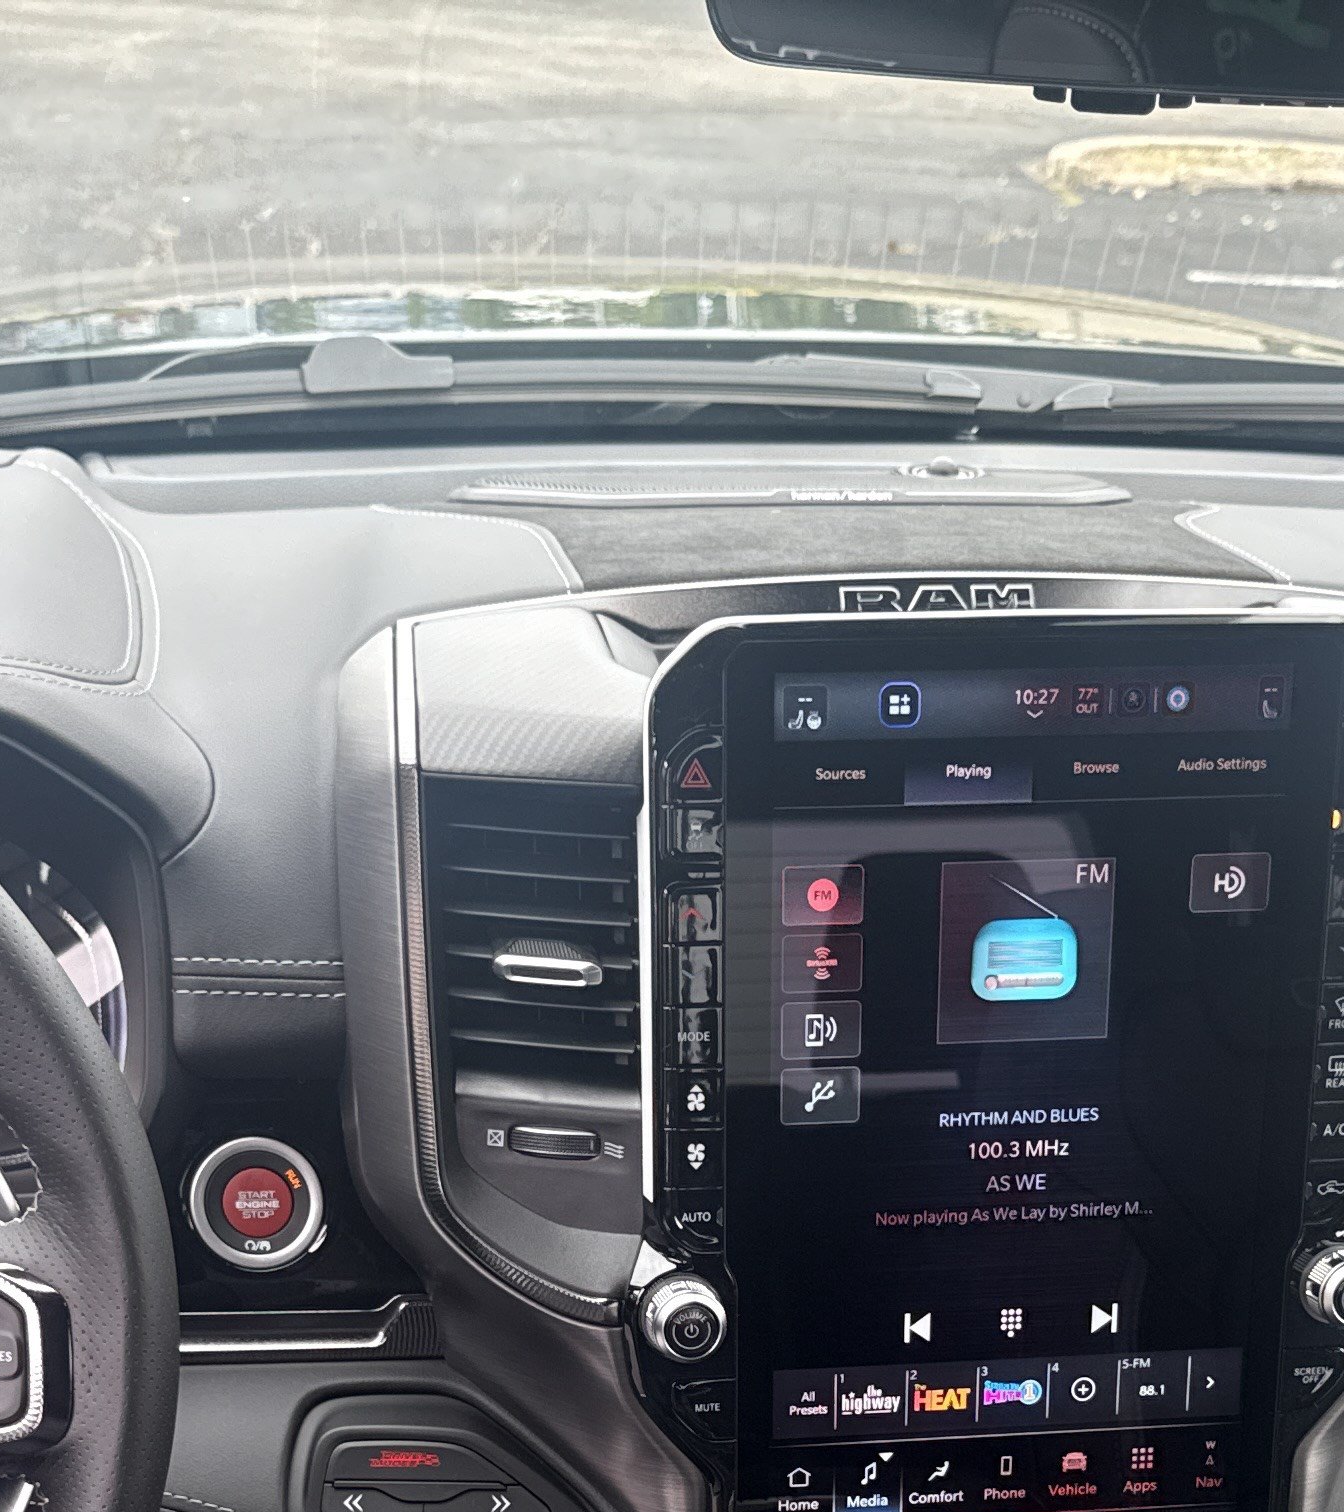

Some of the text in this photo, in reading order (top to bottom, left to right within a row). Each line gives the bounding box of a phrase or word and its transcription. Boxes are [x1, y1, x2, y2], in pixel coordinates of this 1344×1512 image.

[838, 583, 1035, 612] RAM
[1015, 688, 1059, 705] 10:27
[1075, 704, 1098, 714] OUT
[946, 763, 992, 779] Playing
[1073, 761, 1120, 775] Browse
[1177, 757, 1267, 772] Audio Settings
[815, 767, 867, 781] Sources
[1076, 864, 1109, 884] FM
[814, 890, 832, 901] FM
[677, 1031, 711, 1043] MODE
[939, 1107, 1099, 1128] RHYTHM AND BLUES
[968, 1139, 1070, 1160] 100.3 MHz
[986, 1173, 1047, 1192] AS WE
[238, 1190, 276, 1199] START
[235, 1200, 281, 1209] ENGINE
[242, 1210, 275, 1219] STOP
[681, 1211, 712, 1223] AUTO
[875, 1200, 1154, 1228] Now playing As We Lay by Shirley M...
[674, 1311, 707, 1326] VOLUME
[980, 1366, 989, 1377] 3
[1051, 1362, 1060, 1373] 4
[1293, 1366, 1329, 1377] SCREEN
[839, 1373, 845, 1384] 1
[909, 1369, 918, 1381] 2
[801, 1391, 816, 1403] All
[866, 1384, 883, 1398] the
[1138, 1384, 1165, 1397] 88.1
[841, 1391, 901, 1414] highway
[914, 1387, 972, 1412] HEAT
[694, 1403, 721, 1413] MUTE
[789, 1404, 828, 1416] Presets
[1123, 1480, 1158, 1495] Apps
[1195, 1476, 1223, 1488] Nav
[983, 1486, 1026, 1501] Phone
[1048, 1482, 1097, 1497] Vehicle
[846, 1493, 888, 1509] Media
[908, 1489, 964, 1505] Comfort
[777, 1498, 819, 1512] Home
